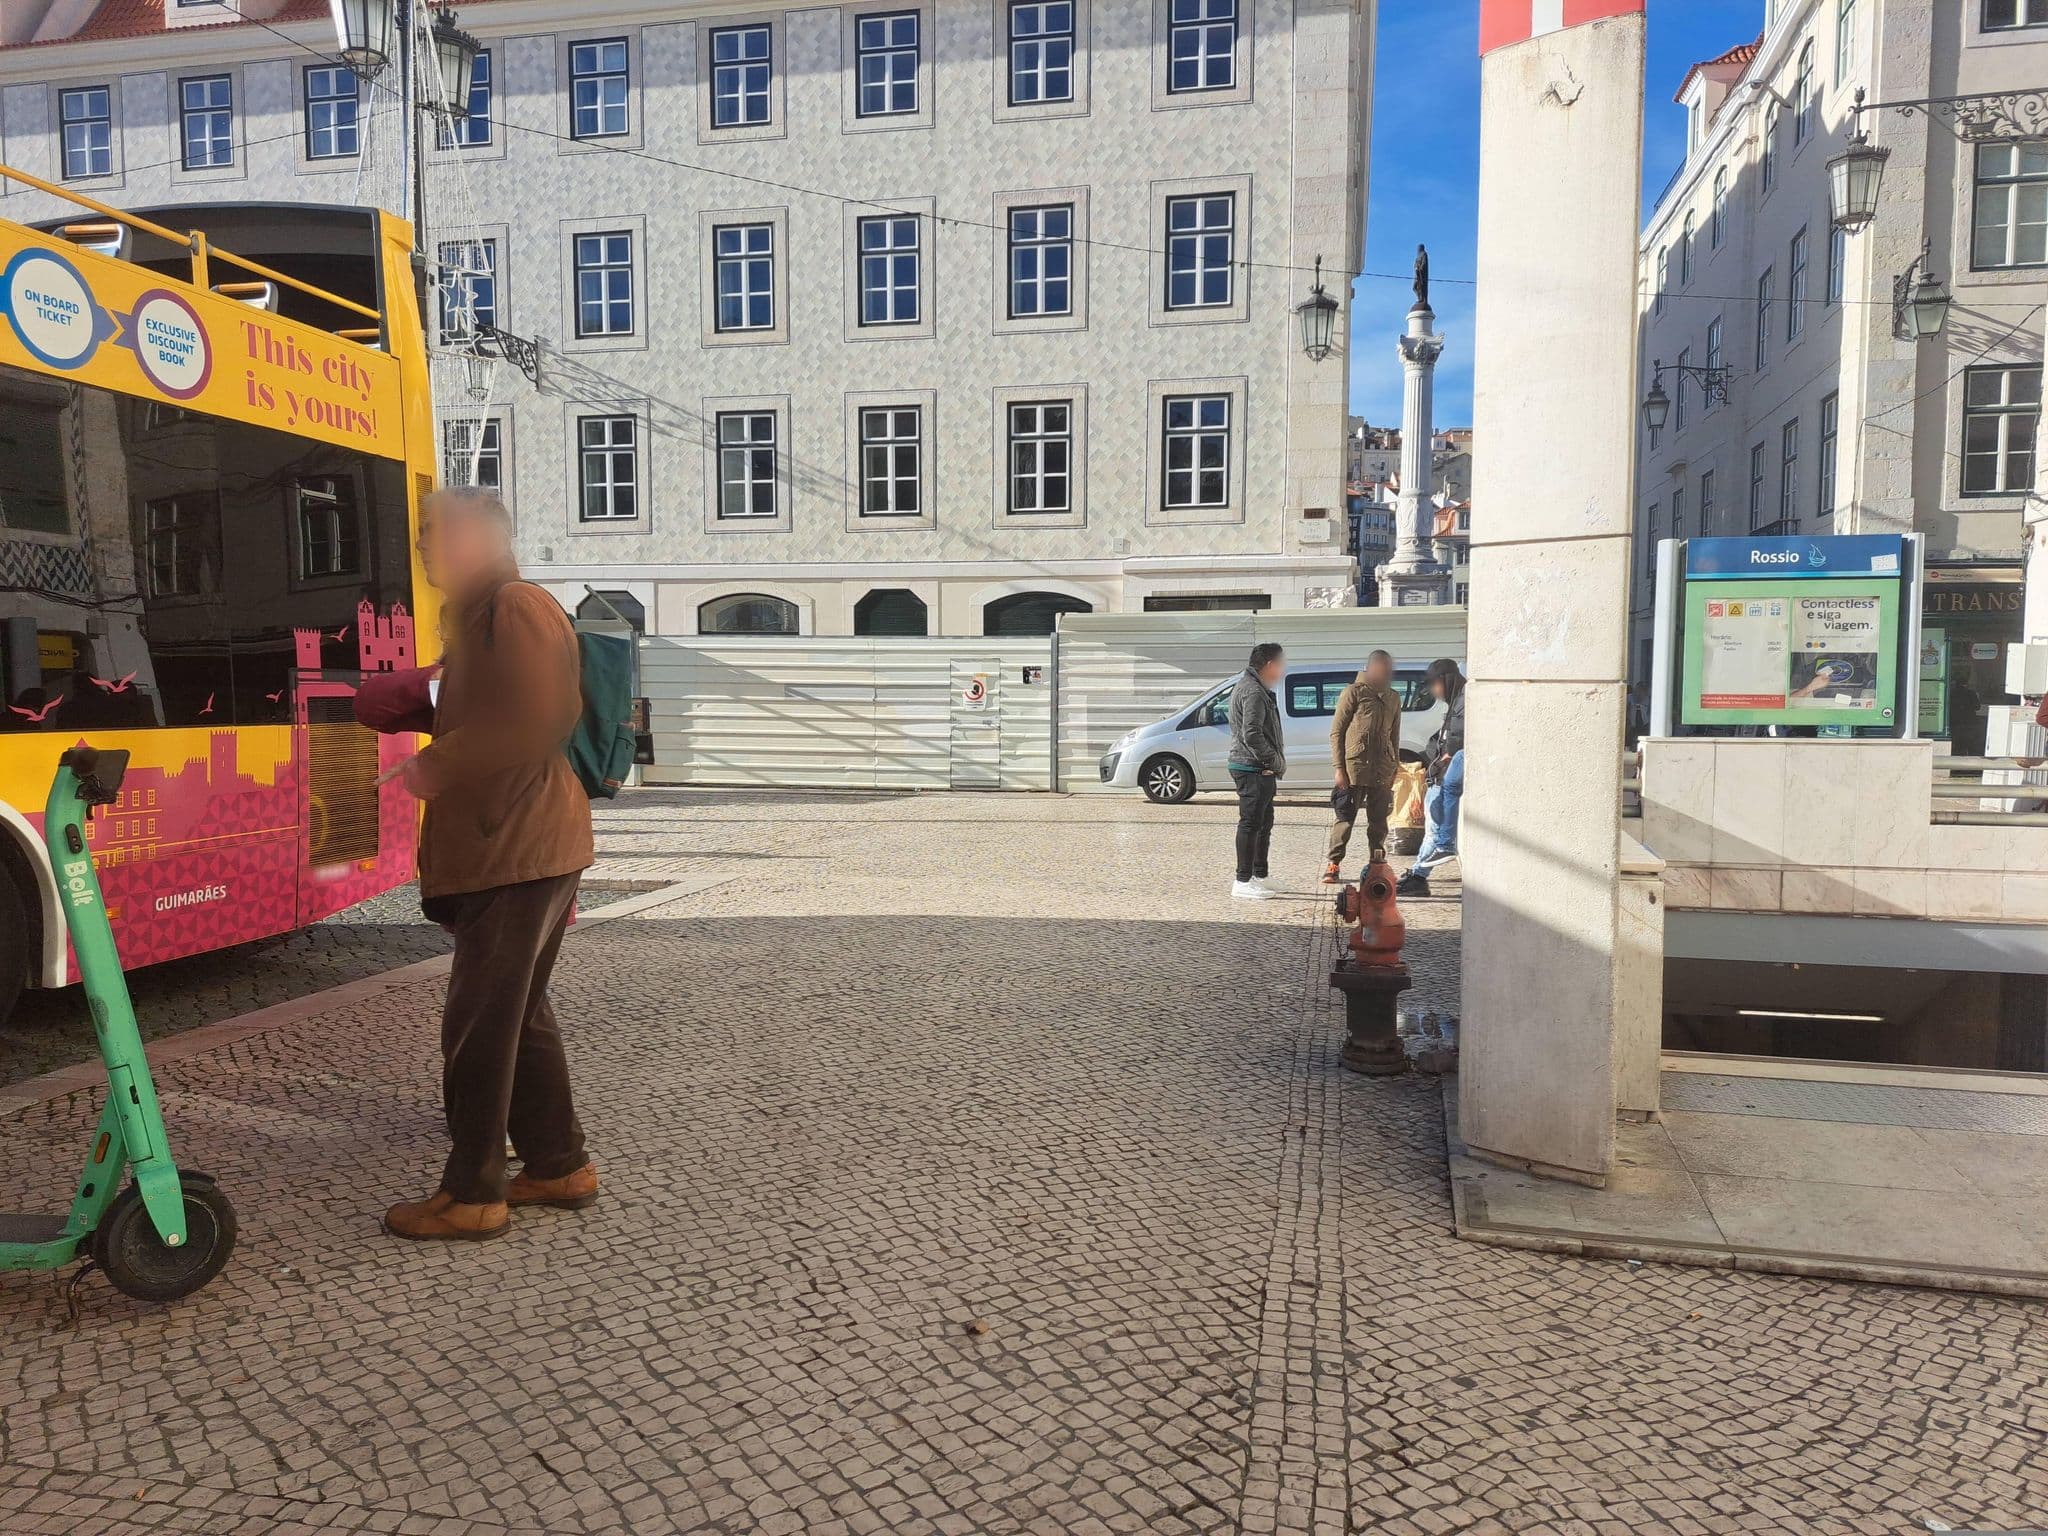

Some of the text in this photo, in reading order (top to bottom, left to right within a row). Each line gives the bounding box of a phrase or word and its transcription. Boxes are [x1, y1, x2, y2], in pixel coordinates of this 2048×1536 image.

[25, 289, 80, 315] ON BOARD
[37, 307, 72, 326] TICKET
[146, 318, 196, 343] EXCLUSIVE
[148, 333, 195, 356] DISCOUNT
[159, 350, 186, 367] BOOK
[240, 320, 375, 402] This city
[246, 370, 378, 440] is yours!
[1751, 550, 1800, 564] Rossio
[1801, 599, 1874, 609] Contactless
[1807, 609, 1841, 622] e siga
[1824, 621, 1874, 632] viagem.
[155, 884, 227, 911] GUIMARÃES
